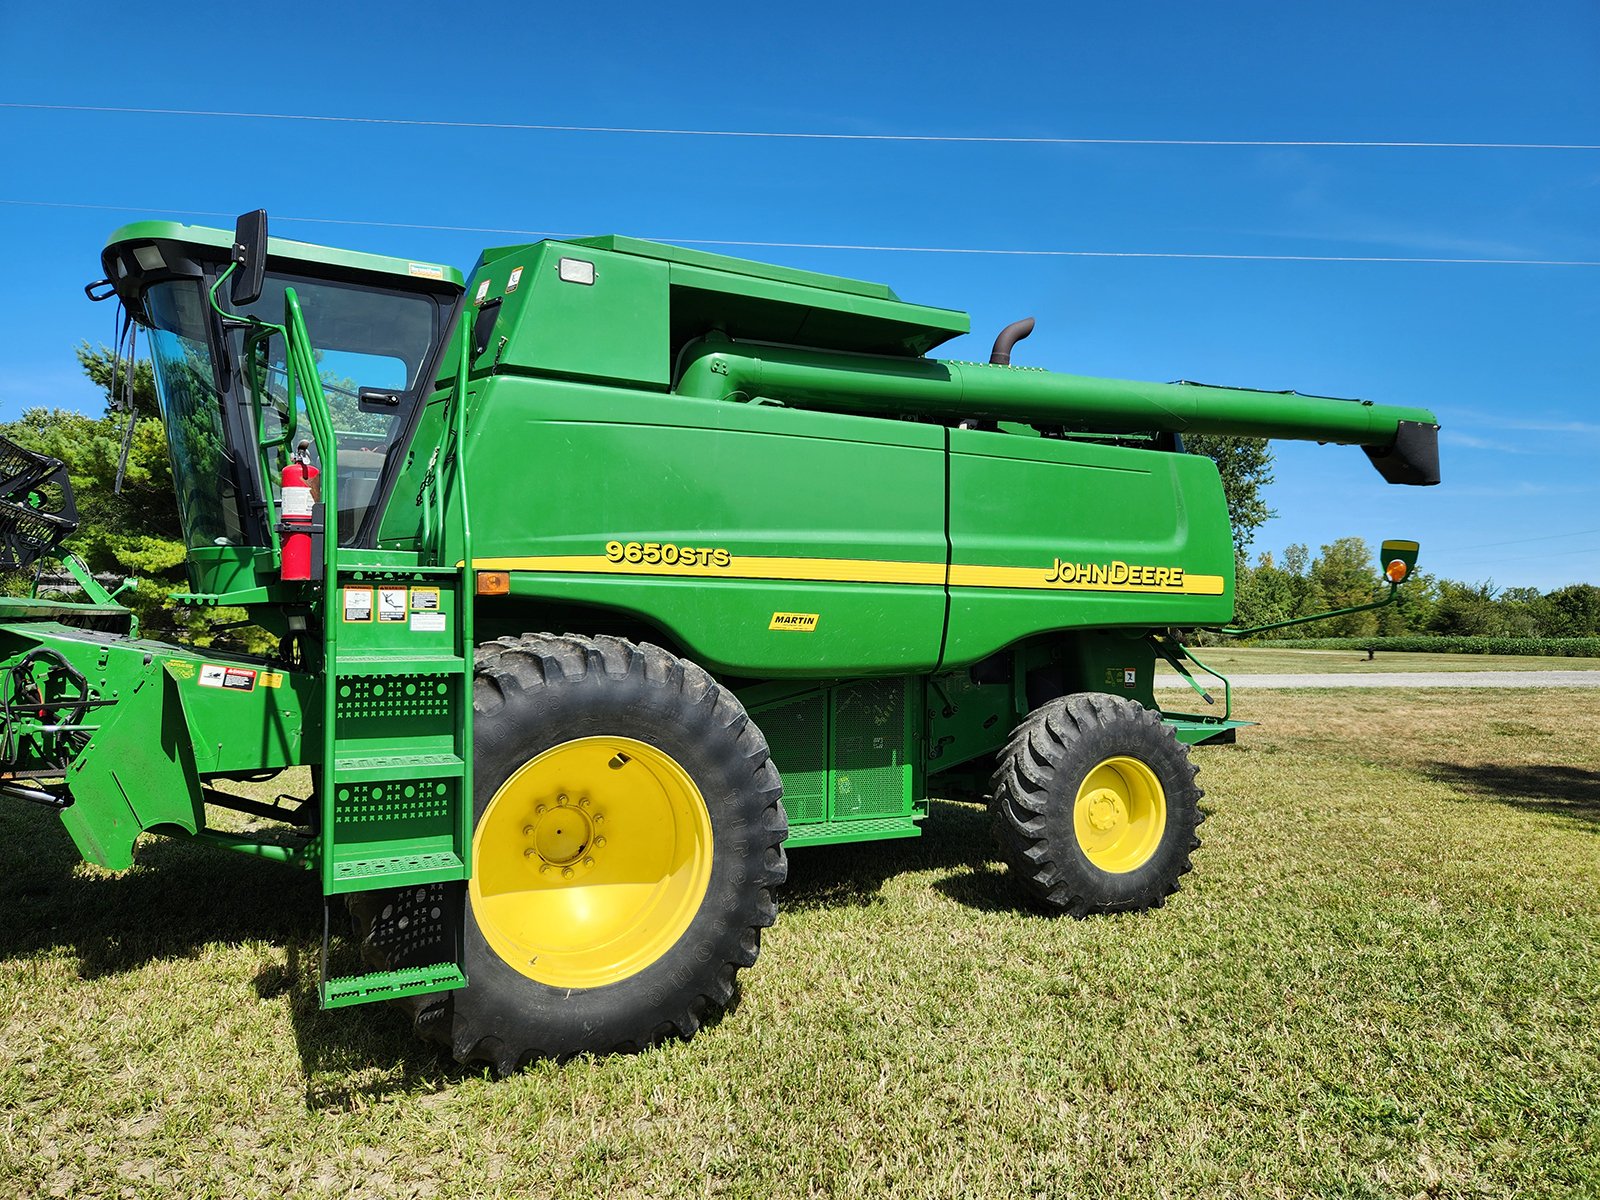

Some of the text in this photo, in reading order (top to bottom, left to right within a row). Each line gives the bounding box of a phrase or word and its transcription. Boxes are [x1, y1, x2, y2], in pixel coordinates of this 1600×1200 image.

[605, 540, 731, 567] 9650STS
[1045, 557, 1184, 588] JOHN DEERE
[775, 616, 815, 625] MARTIN
